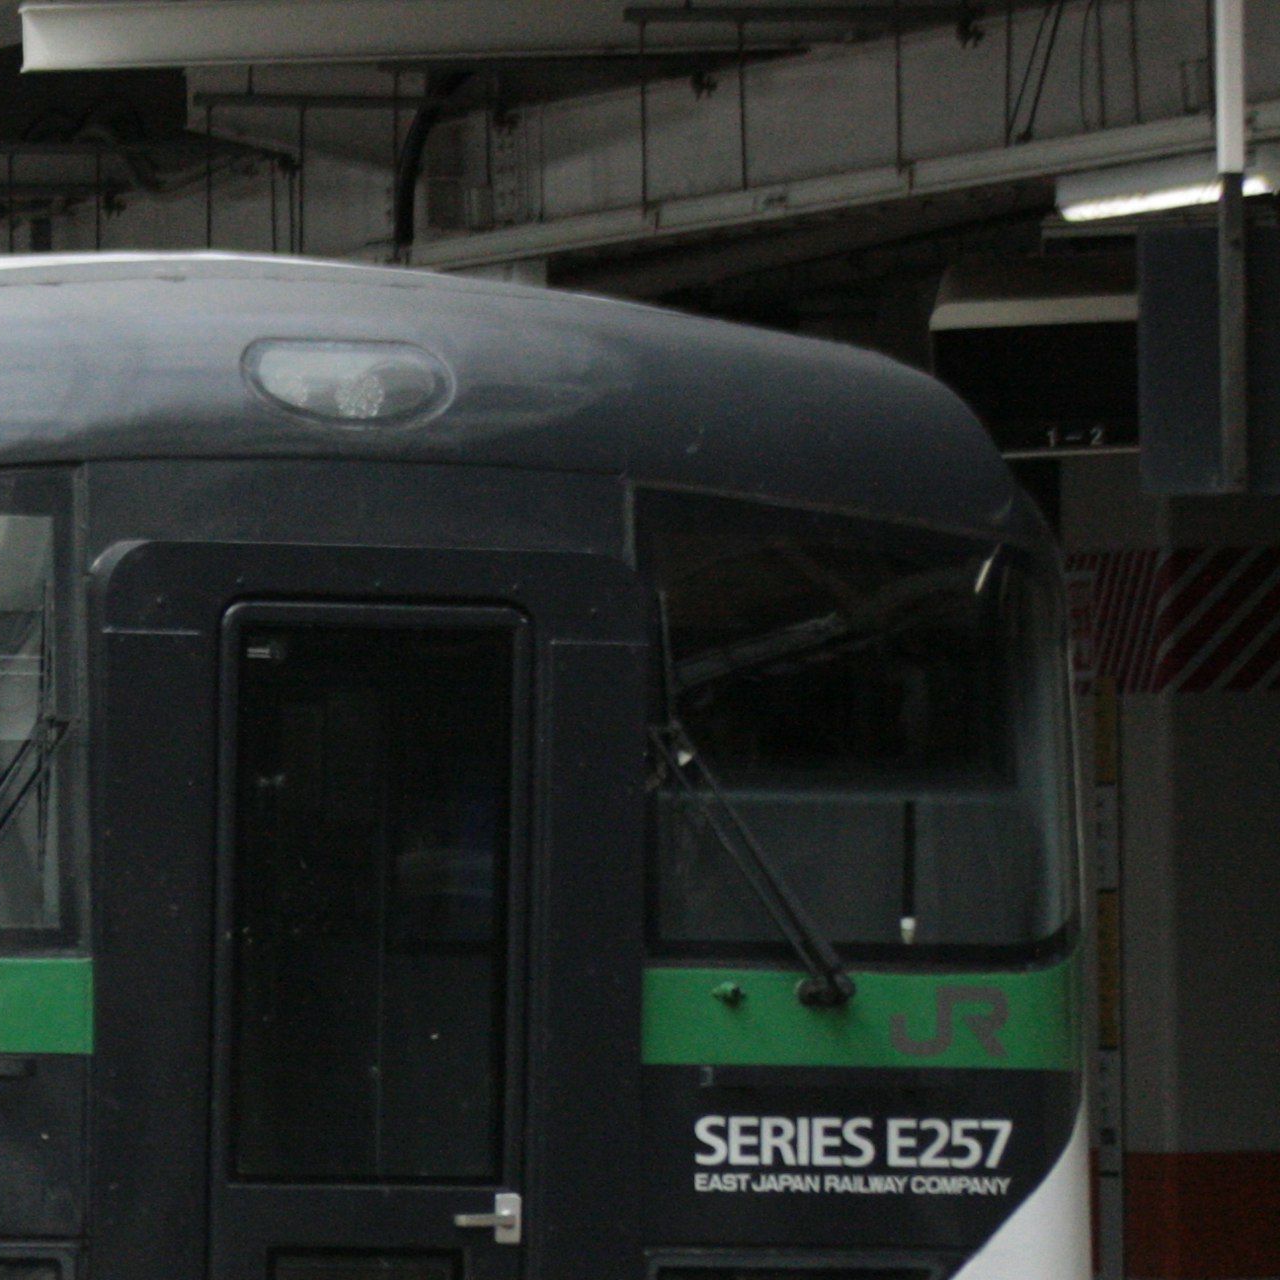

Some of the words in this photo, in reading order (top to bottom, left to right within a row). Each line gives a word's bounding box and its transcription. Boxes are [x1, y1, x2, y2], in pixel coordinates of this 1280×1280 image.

[889, 985, 1009, 1057] JR
[694, 1115, 875, 1167] SERIES
[887, 1118, 1013, 1168] E257
[694, 1172, 750, 1192] EAST
[751, 1173, 820, 1193] JAPAN
[824, 1175, 908, 1194] RAILWAY
[910, 1176, 1011, 1195] COMPANY
